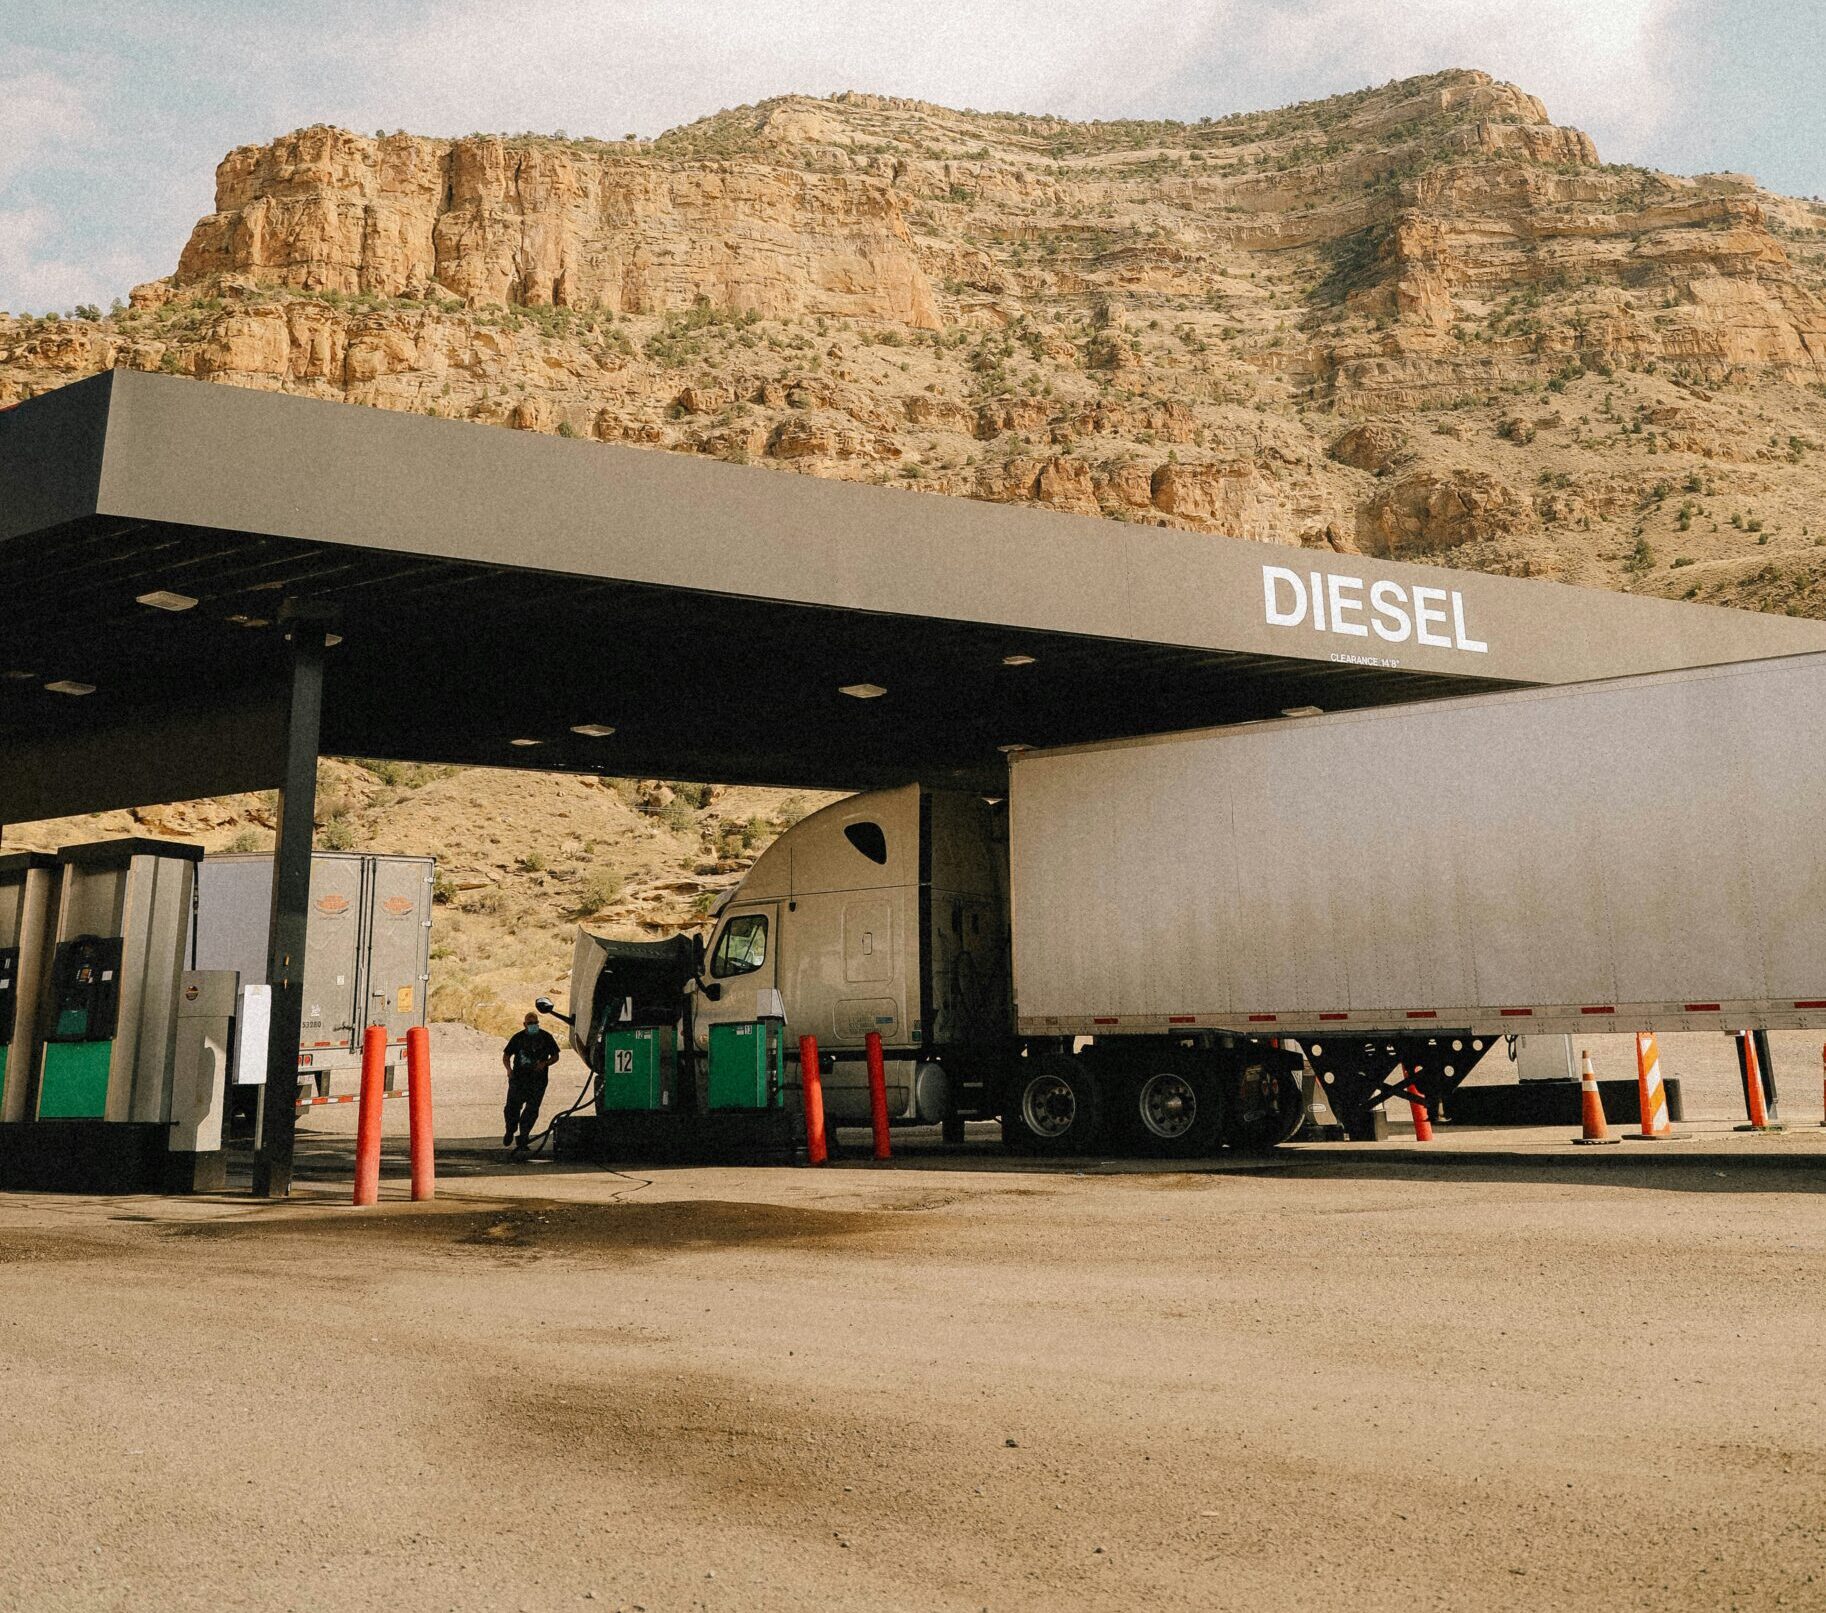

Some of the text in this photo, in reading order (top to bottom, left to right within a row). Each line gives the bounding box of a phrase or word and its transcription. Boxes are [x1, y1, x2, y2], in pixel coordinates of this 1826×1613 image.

[1262, 565, 1488, 653] DIESEL
[1330, 653, 1378, 666] CLEARANCE
[616, 1050, 632, 1072] 12
